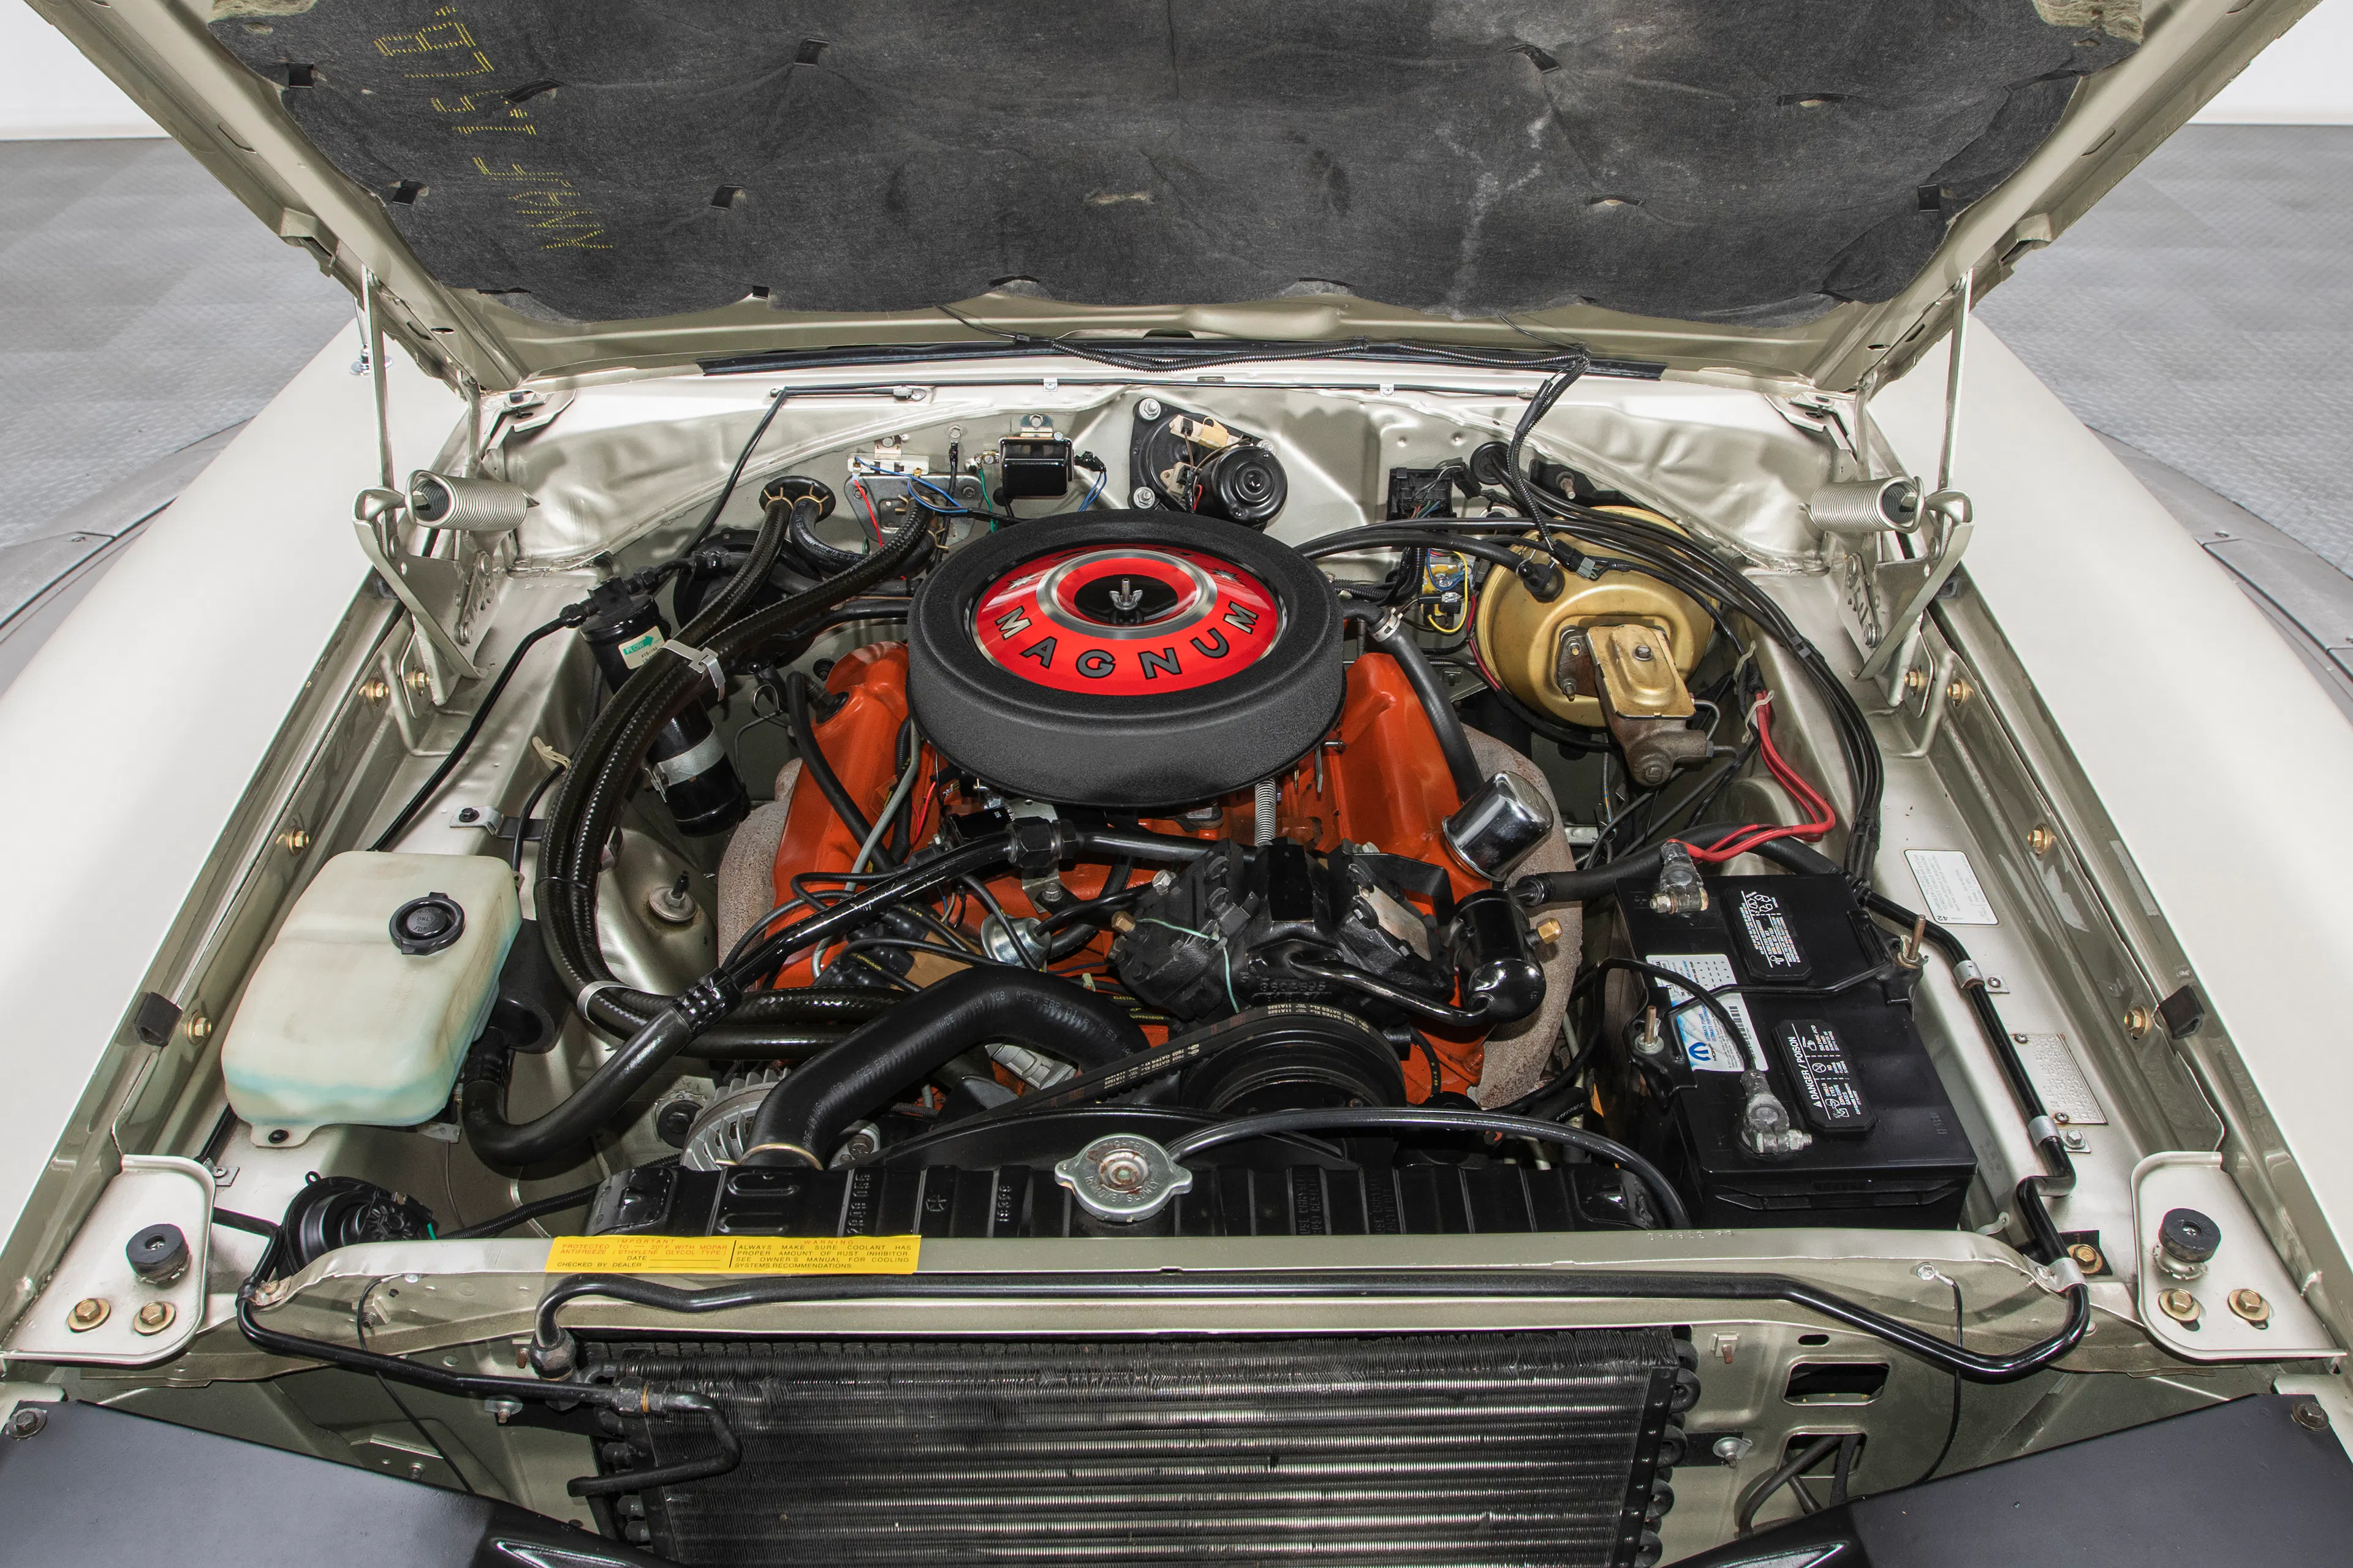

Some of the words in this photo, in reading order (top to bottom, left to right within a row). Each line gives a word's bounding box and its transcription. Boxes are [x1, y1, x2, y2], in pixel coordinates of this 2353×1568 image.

[995, 600, 1260, 680] MAGNUM
[626, 642, 643, 654] FLOW
[1322, 1007, 1341, 1015] GATES
[1697, 1013, 1706, 1025] POWER
[1708, 1025, 1717, 1042] ULTIMATE
[1787, 1037, 1805, 1063] POISON
[1152, 1059, 1170, 1068] GATES
[1800, 1069, 1819, 1100] DANGER
[1820, 1083, 1832, 1097] SHIELD
[1827, 1086, 1837, 1096] EYES
[1832, 1084, 1847, 1105] EXPLOSIVE
[1841, 1091, 1852, 1105] GASES
[1085, 1176, 1118, 1202] REMOVE
[1127, 1179, 1159, 1202] SLOWLY
